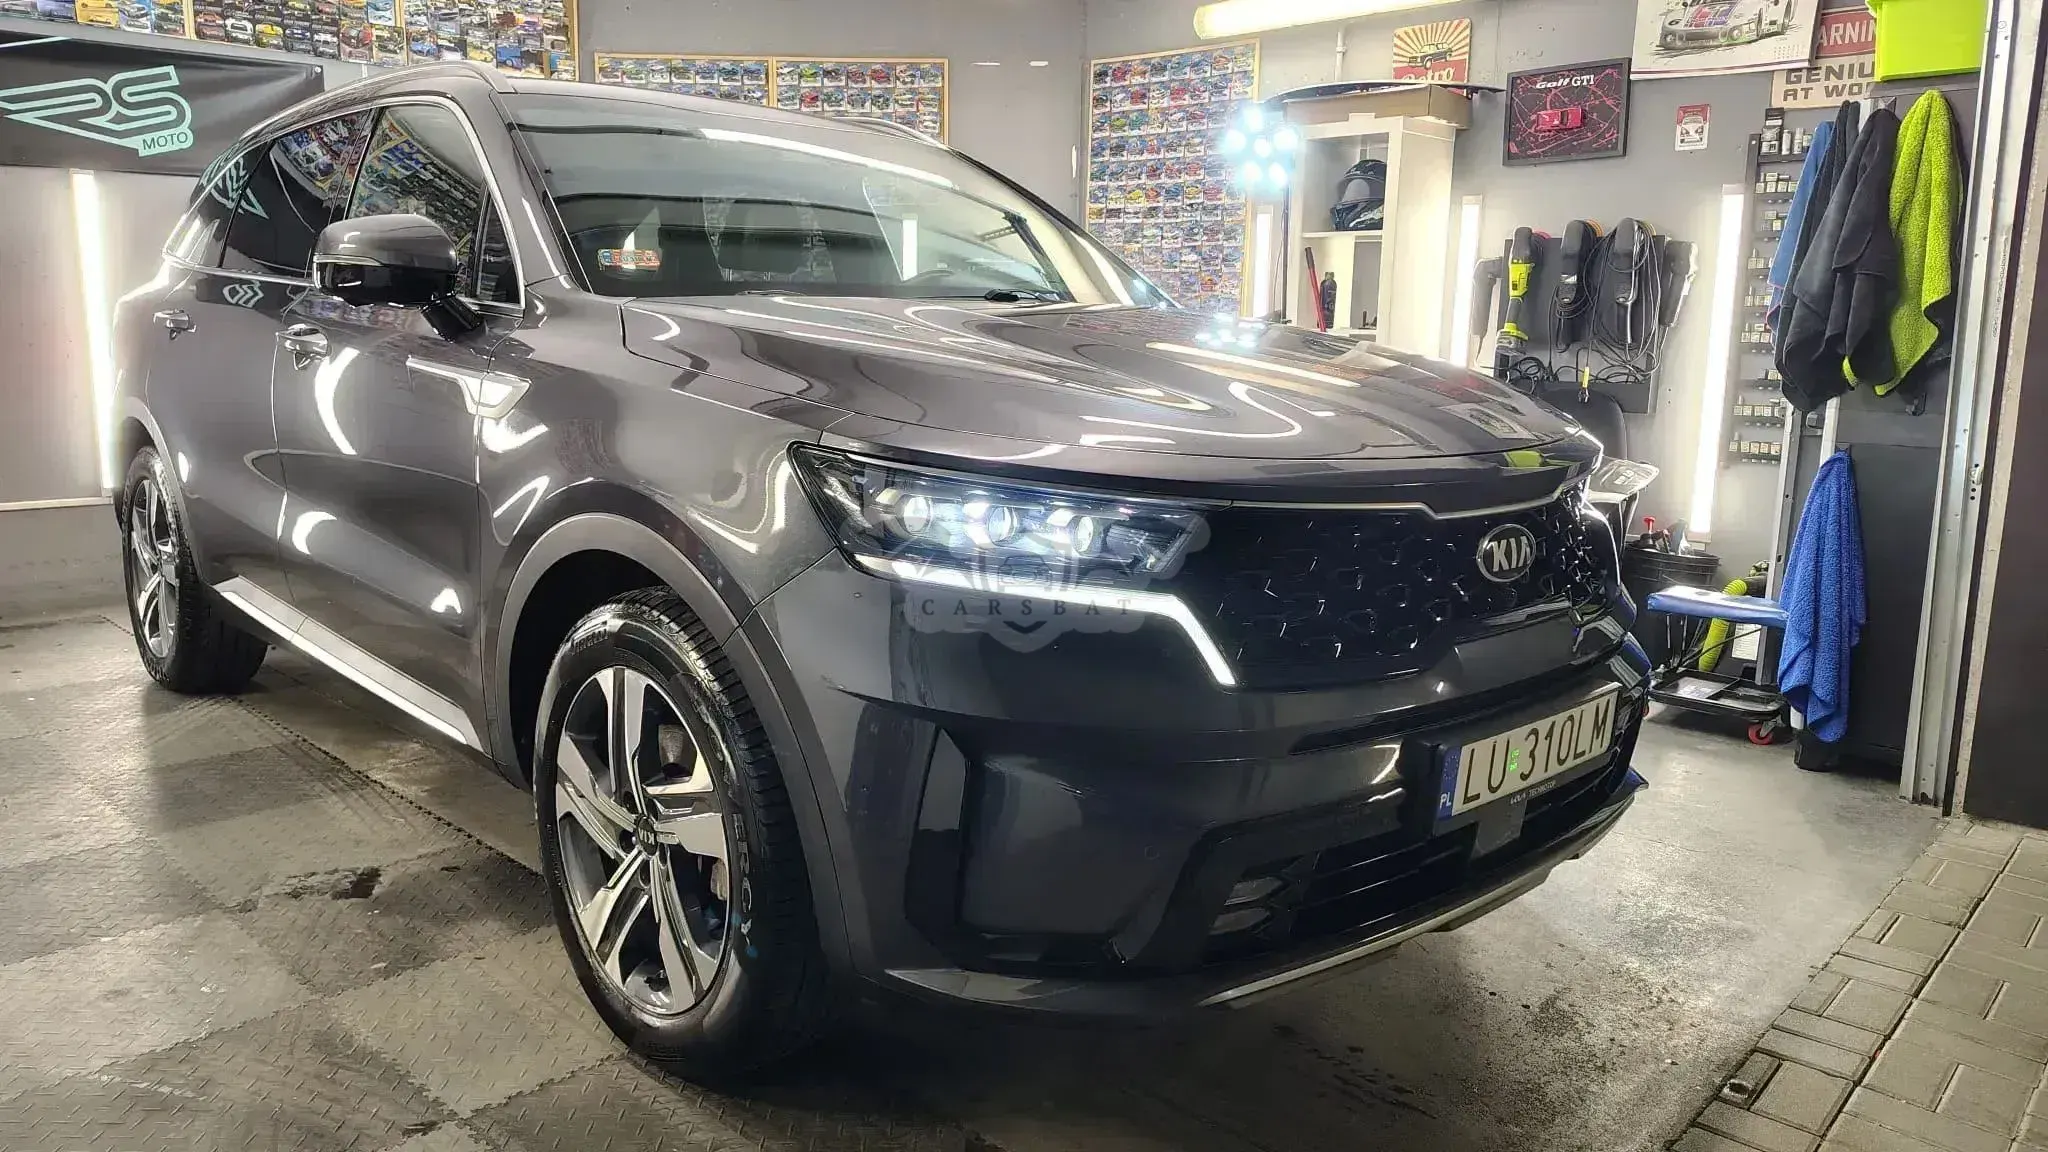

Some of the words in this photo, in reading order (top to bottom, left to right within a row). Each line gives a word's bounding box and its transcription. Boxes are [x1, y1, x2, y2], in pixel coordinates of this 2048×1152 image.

[1571, 74, 1595, 87] GTI
[1785, 60, 1876, 85] GENIU
[1783, 86, 1814, 102] AT
[142, 131, 188, 150] MOTO
[1486, 535, 1531, 572] KIA
[1462, 739, 1510, 804] LU
[1520, 698, 1611, 782] 310LM
[1439, 792, 1452, 810] PL
[638, 827, 655, 846] KIA
